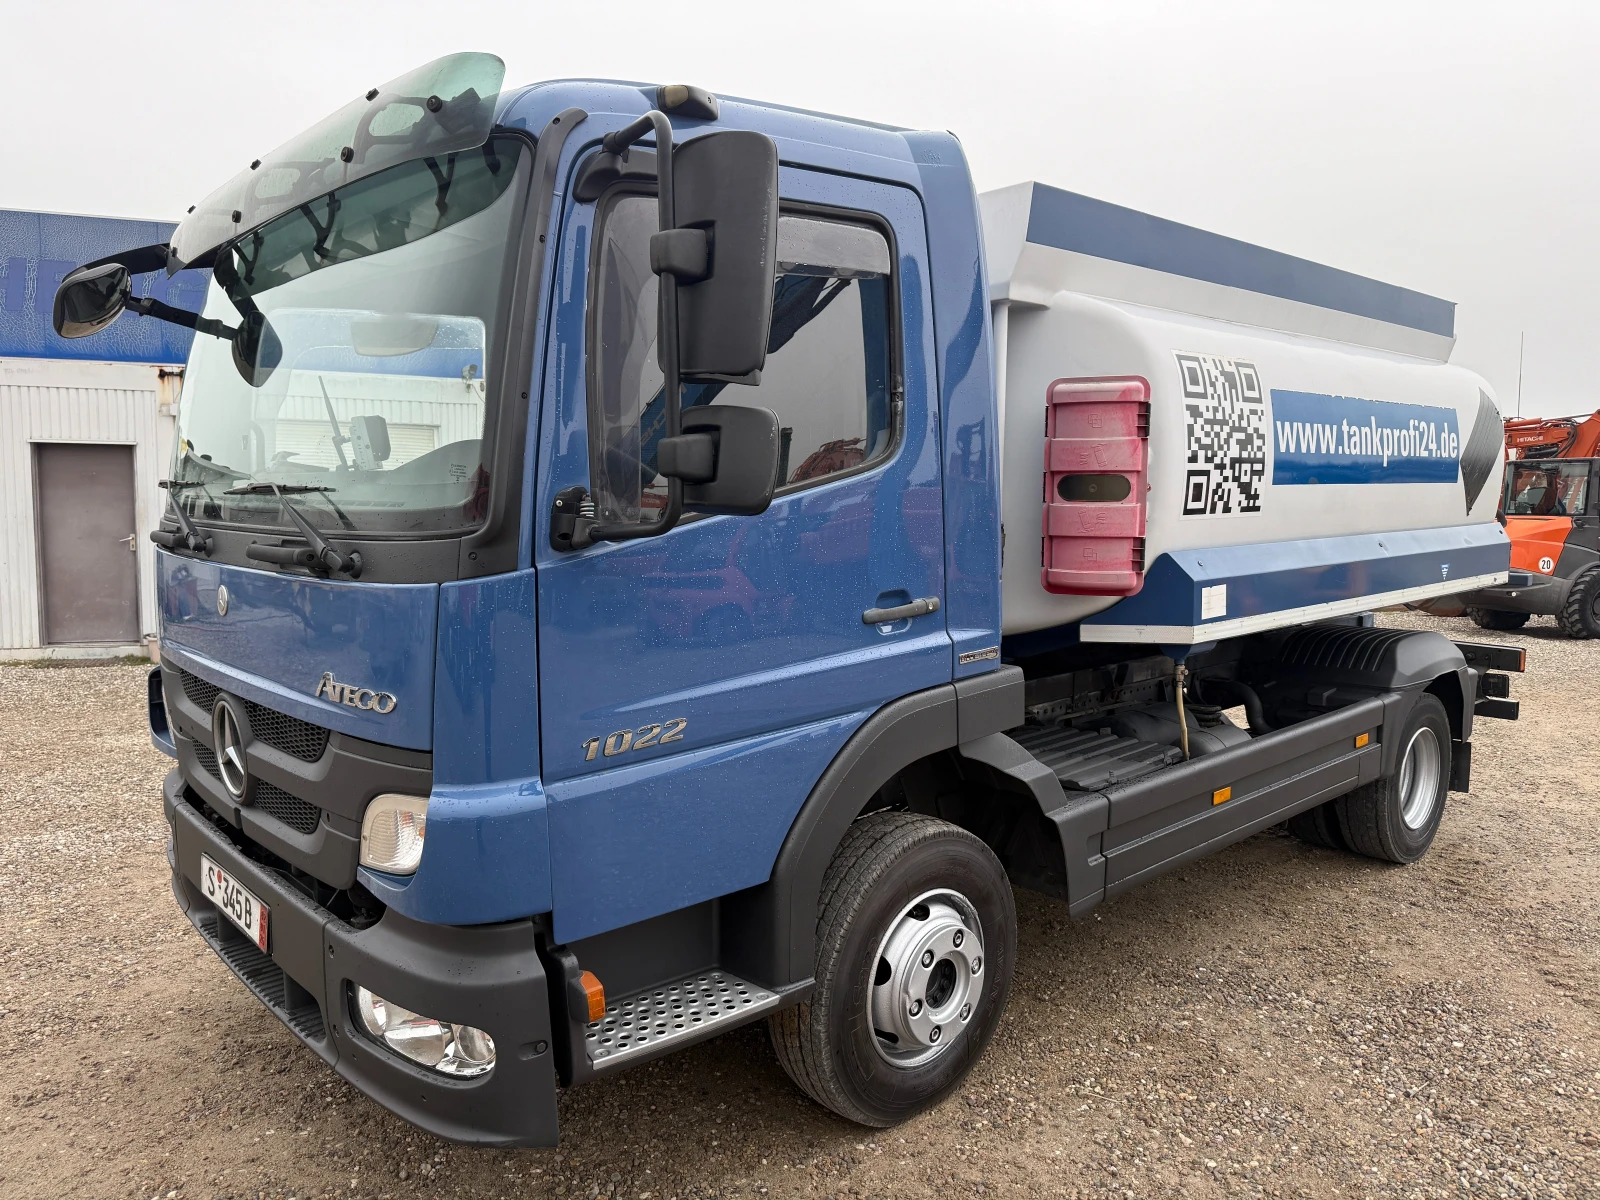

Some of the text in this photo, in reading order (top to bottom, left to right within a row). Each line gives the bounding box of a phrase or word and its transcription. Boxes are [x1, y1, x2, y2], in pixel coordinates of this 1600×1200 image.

[1276, 416, 1458, 467] www.tankprofi24.de
[1516, 435, 1544, 443] HITACHI
[1541, 559, 1551, 570] 20
[582, 717, 688, 761] 1022
